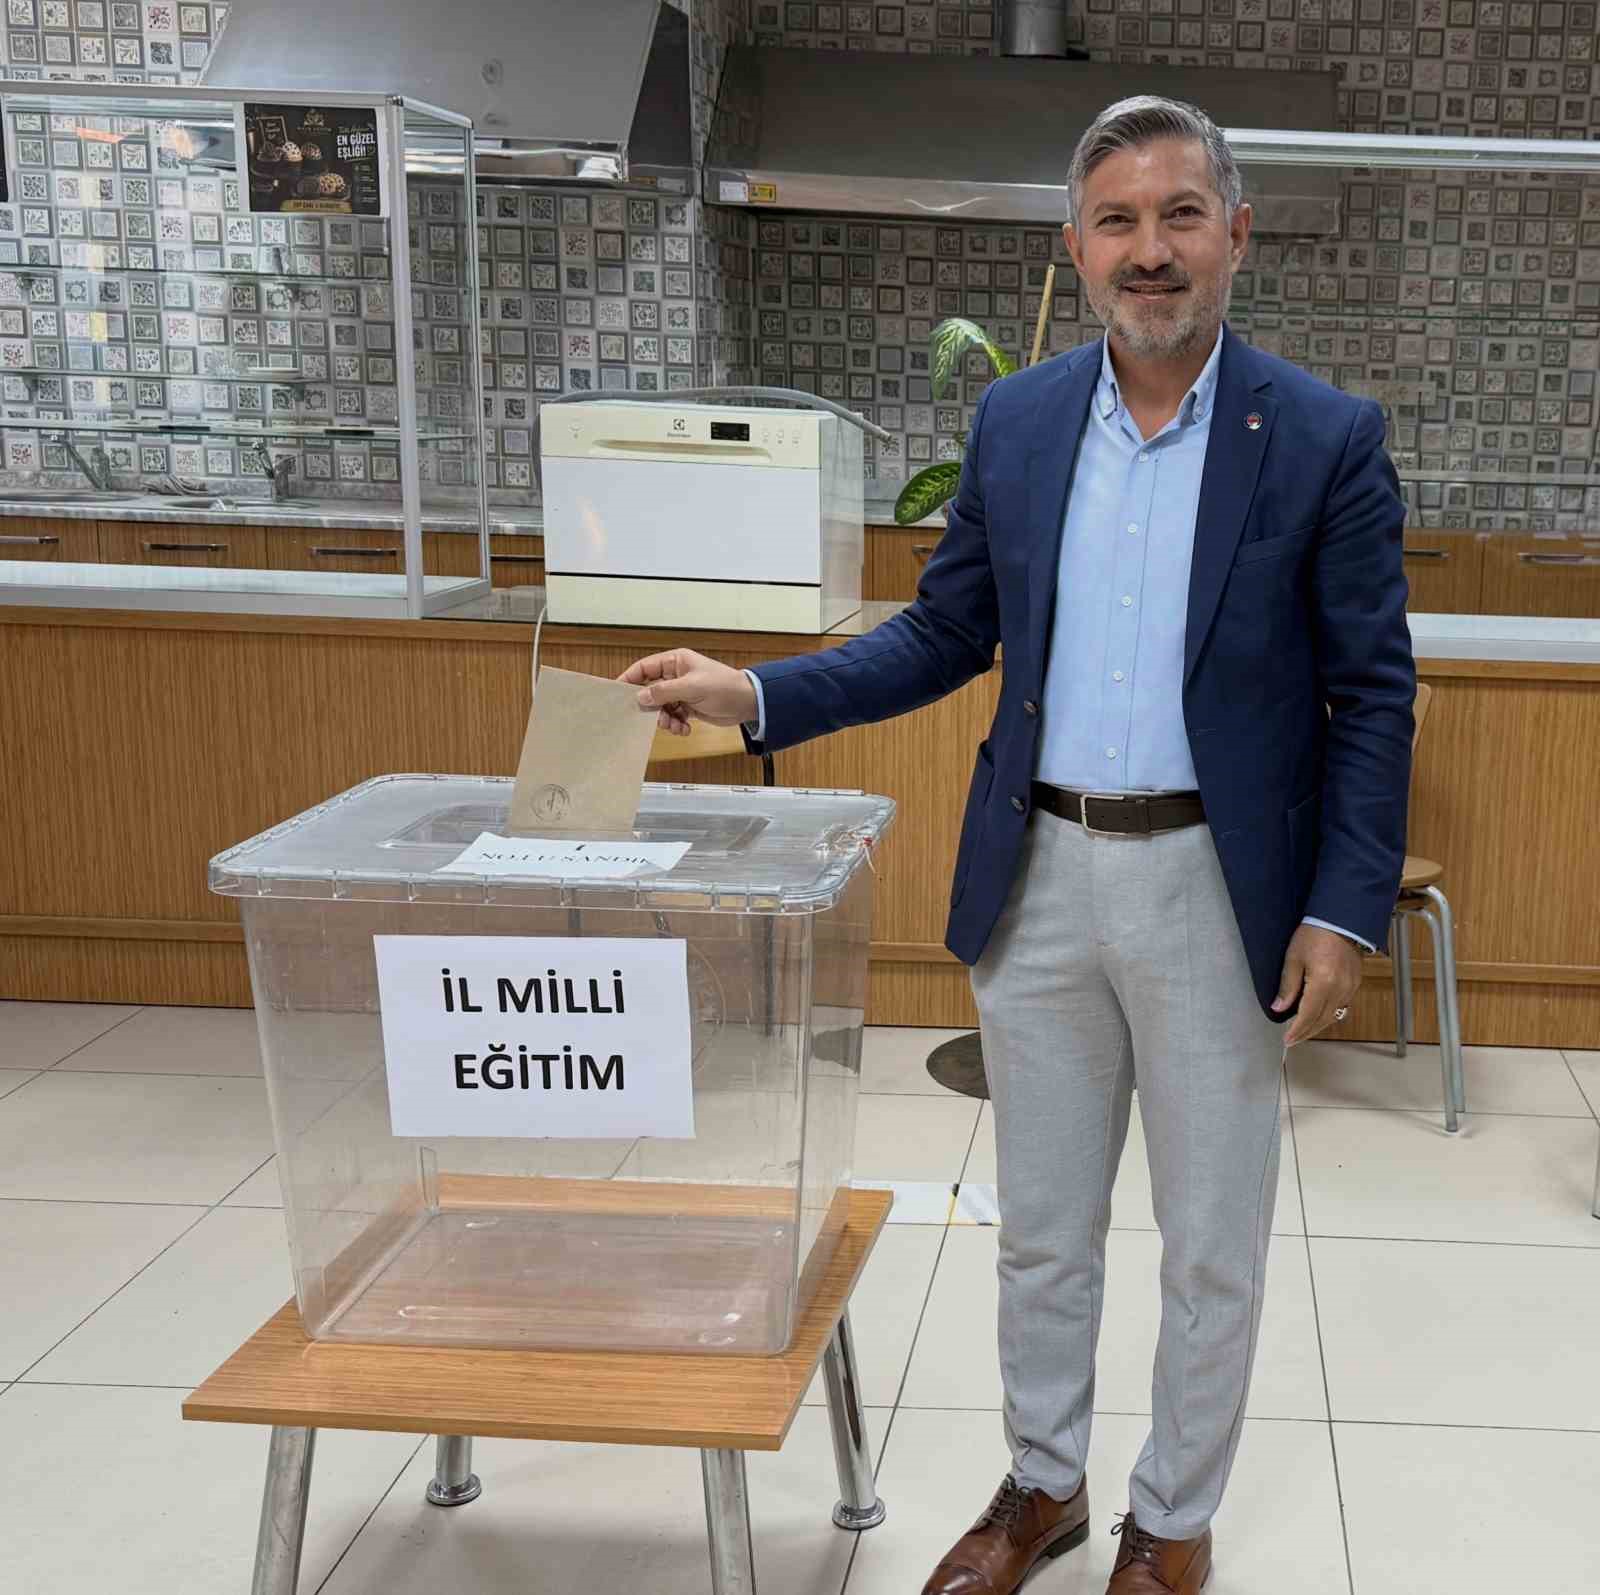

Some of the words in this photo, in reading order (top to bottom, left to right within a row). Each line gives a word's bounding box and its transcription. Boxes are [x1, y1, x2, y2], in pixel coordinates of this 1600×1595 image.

[337, 135, 348, 146] EN
[350, 132, 376, 145] GÜZEL
[442, 967, 483, 1013] İL
[497, 968, 625, 1014] MİLLİ
[454, 1043, 625, 1091] EĞİTİM
